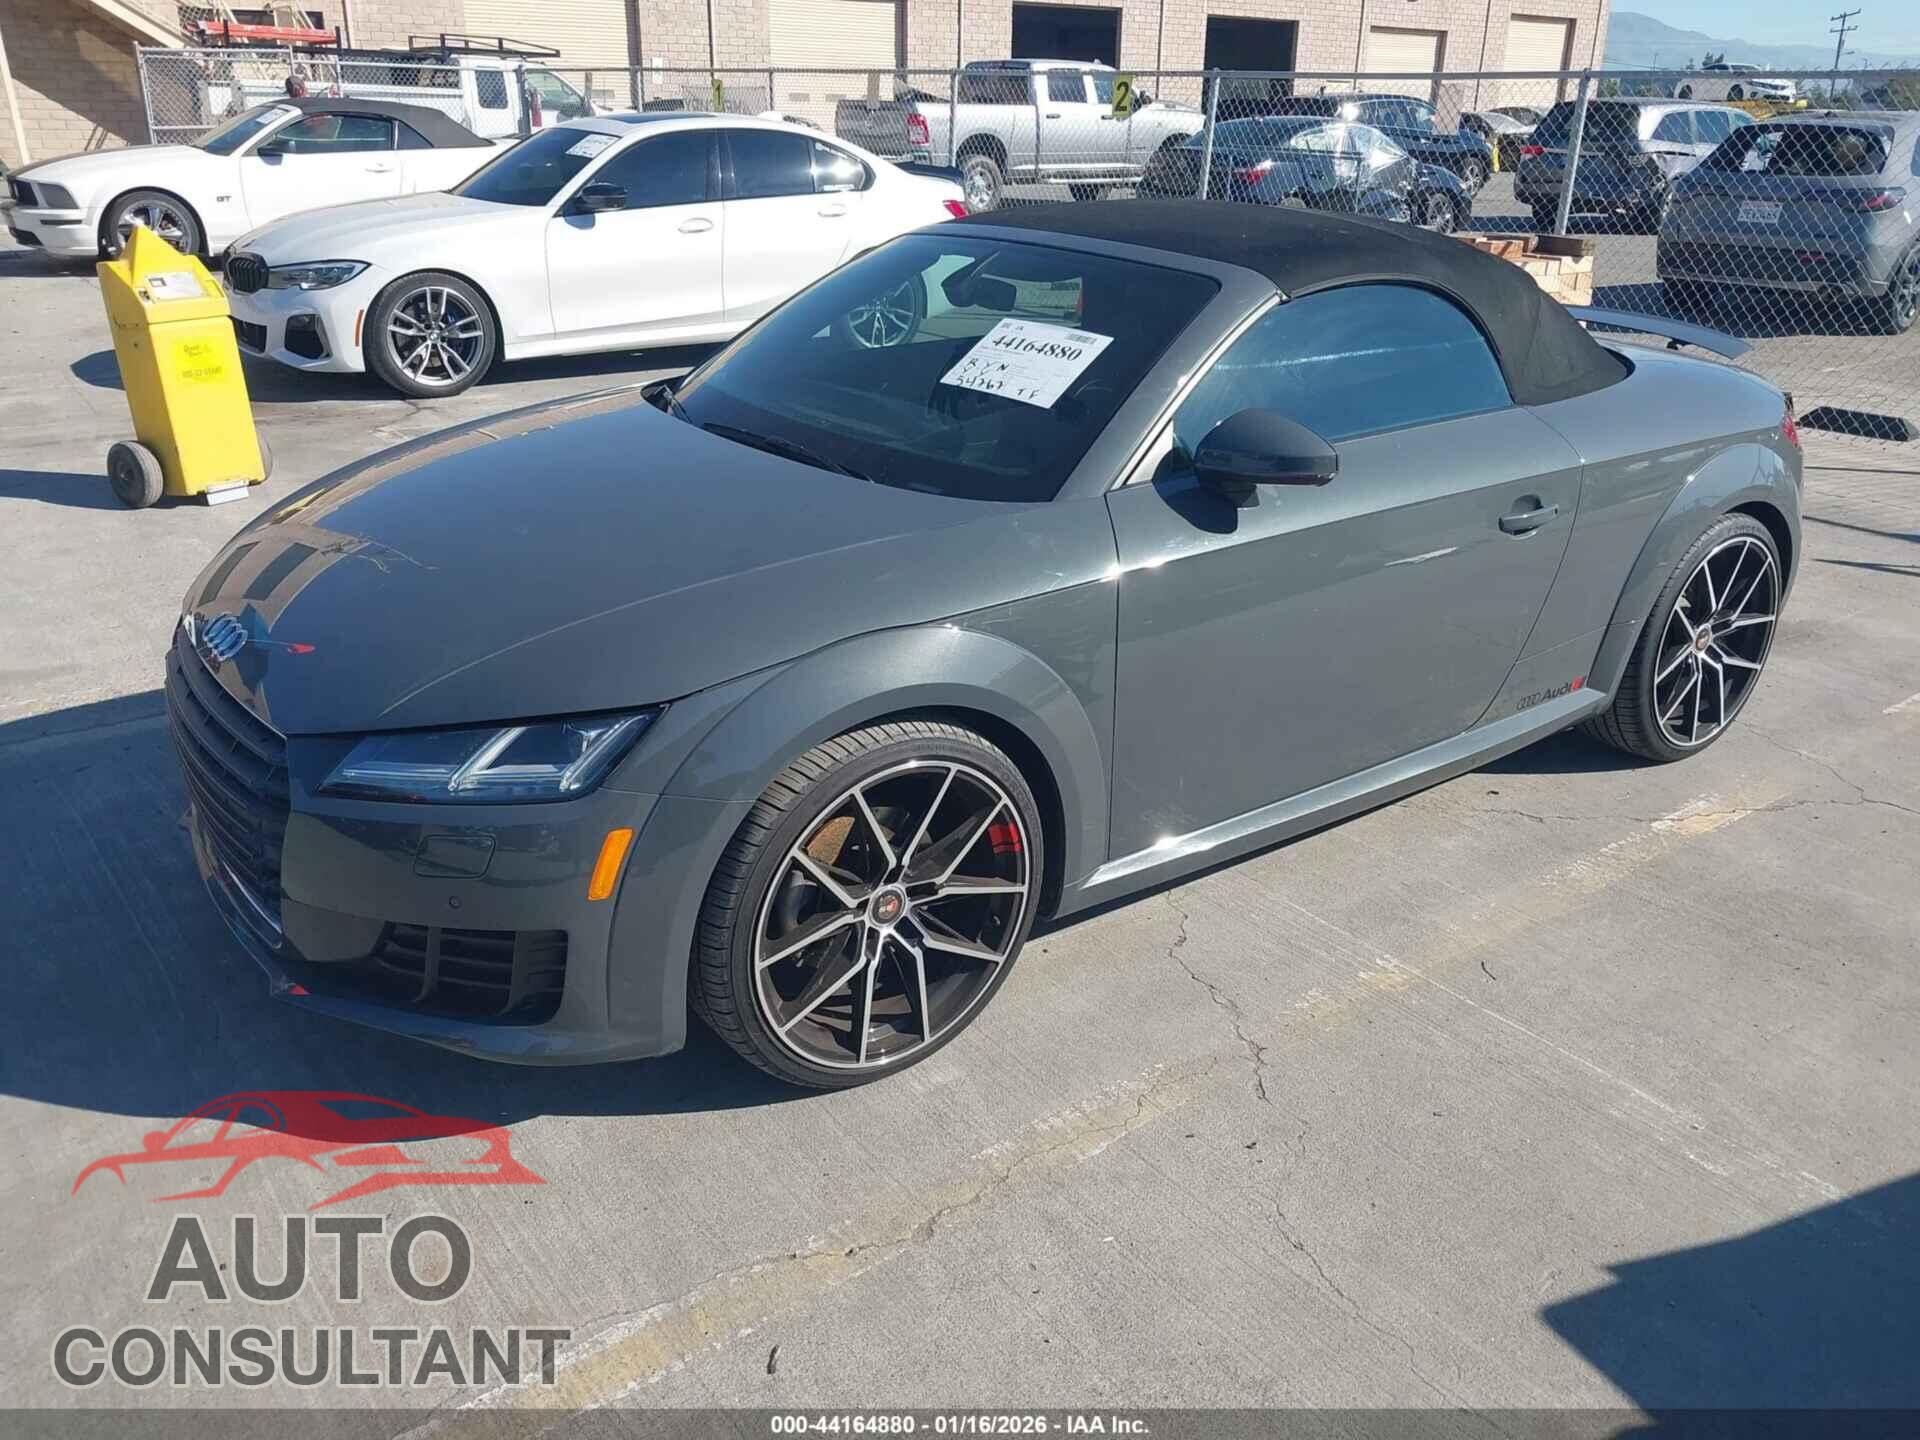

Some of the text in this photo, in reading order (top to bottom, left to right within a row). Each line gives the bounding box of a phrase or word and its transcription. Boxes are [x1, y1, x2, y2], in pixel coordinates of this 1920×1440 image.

[714, 83, 721, 106] 1
[1114, 81, 1130, 112] 2
[216, 195, 232, 203] GT
[992, 334, 1083, 361] 44164880
